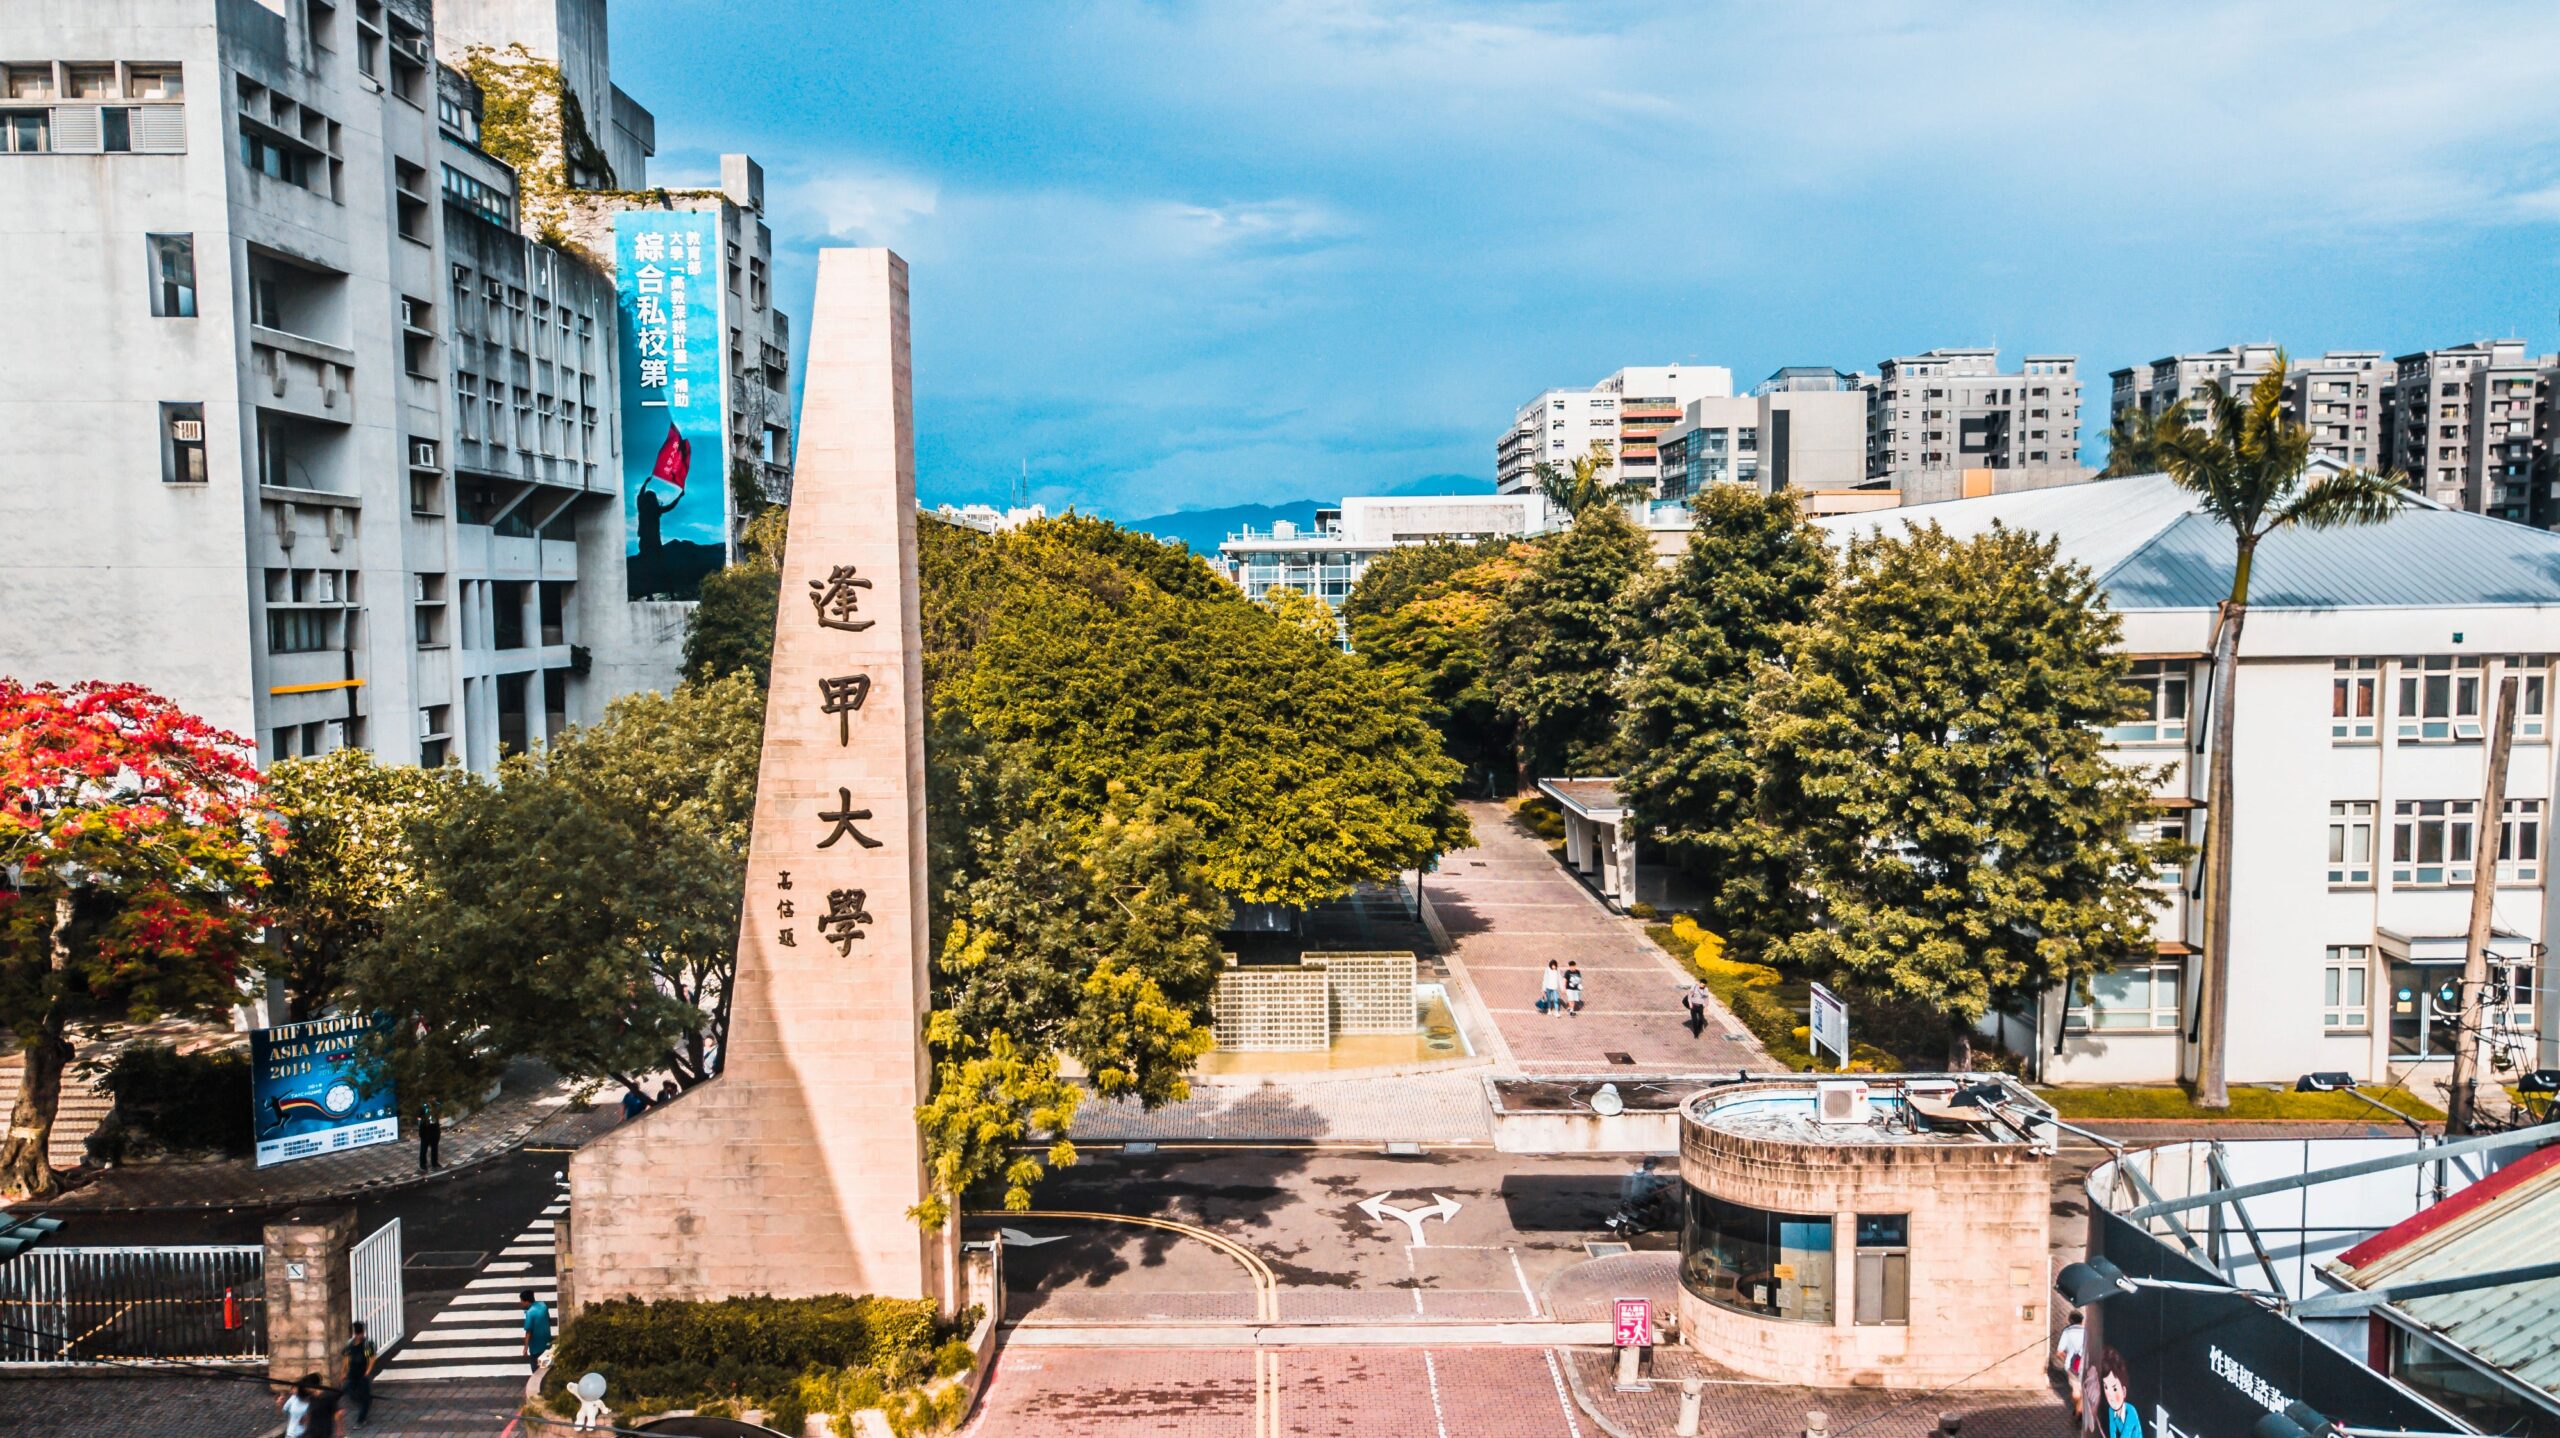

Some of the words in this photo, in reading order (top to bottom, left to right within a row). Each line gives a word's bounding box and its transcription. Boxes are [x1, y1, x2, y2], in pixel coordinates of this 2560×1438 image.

[686, 231, 702, 276] 教育部
[634, 231, 669, 407] 綜合私校第一
[808, 564, 883, 958] 逢甲大學
[269, 1043, 310, 1061] ASIA
[270, 1061, 311, 1080] 2019
[2209, 1344, 2293, 1413] 性騷擾諮詢
